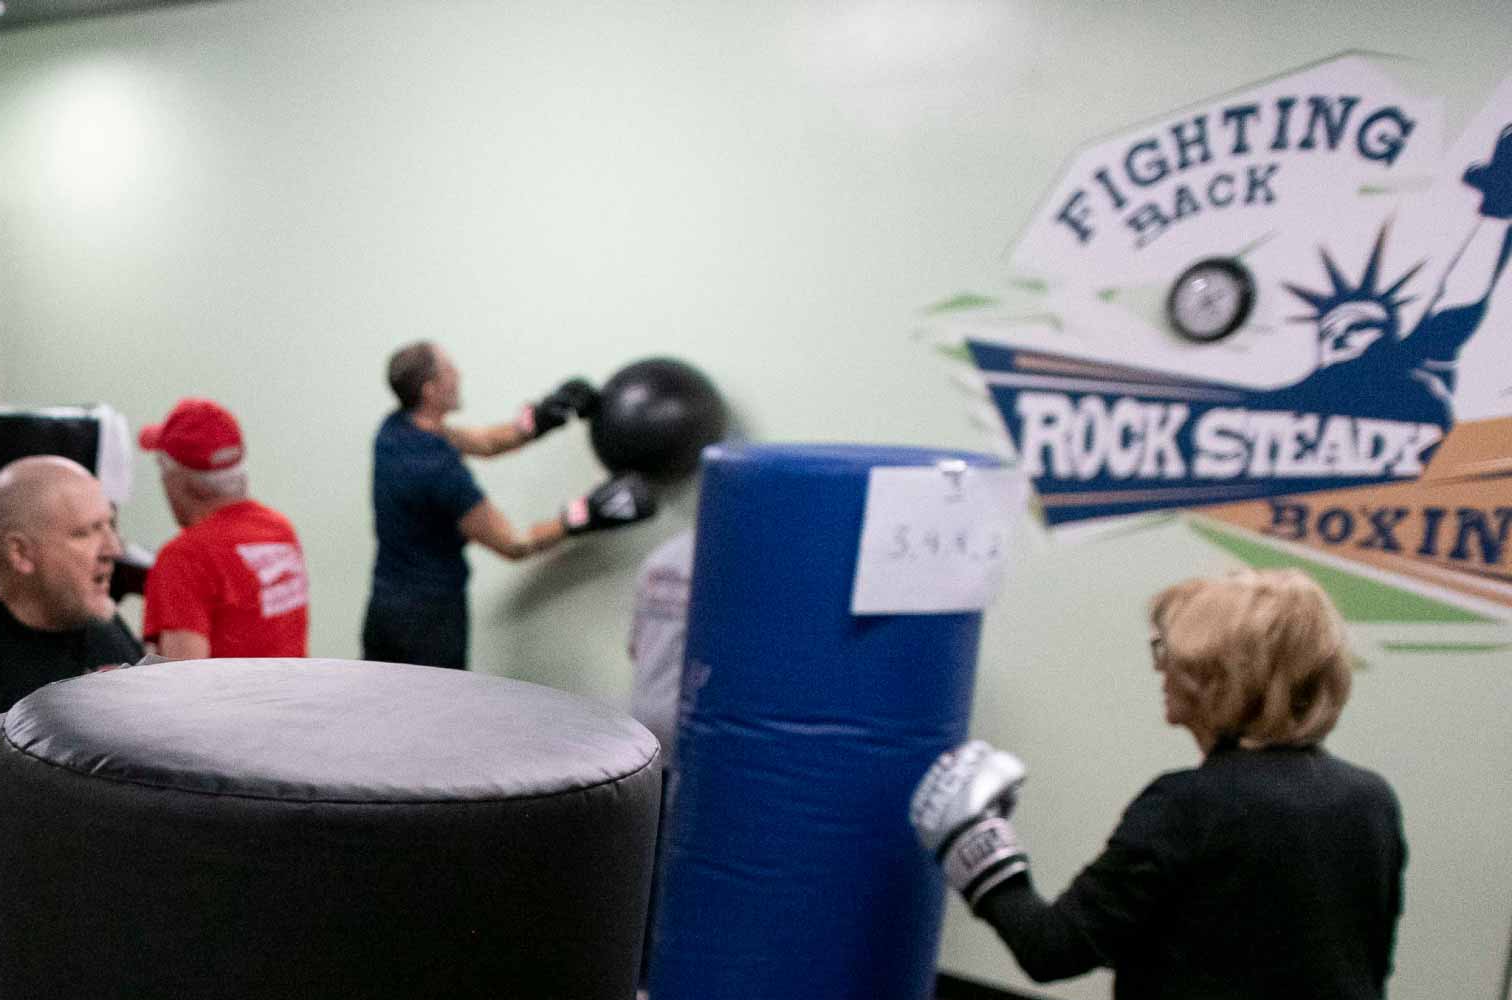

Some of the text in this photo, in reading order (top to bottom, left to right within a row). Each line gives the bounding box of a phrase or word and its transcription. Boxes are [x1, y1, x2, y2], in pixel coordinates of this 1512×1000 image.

[1055, 96, 1417, 244] FIGHTING
[1126, 163, 1280, 238] BACK
[1017, 391, 1444, 480] ROCK STEADY
